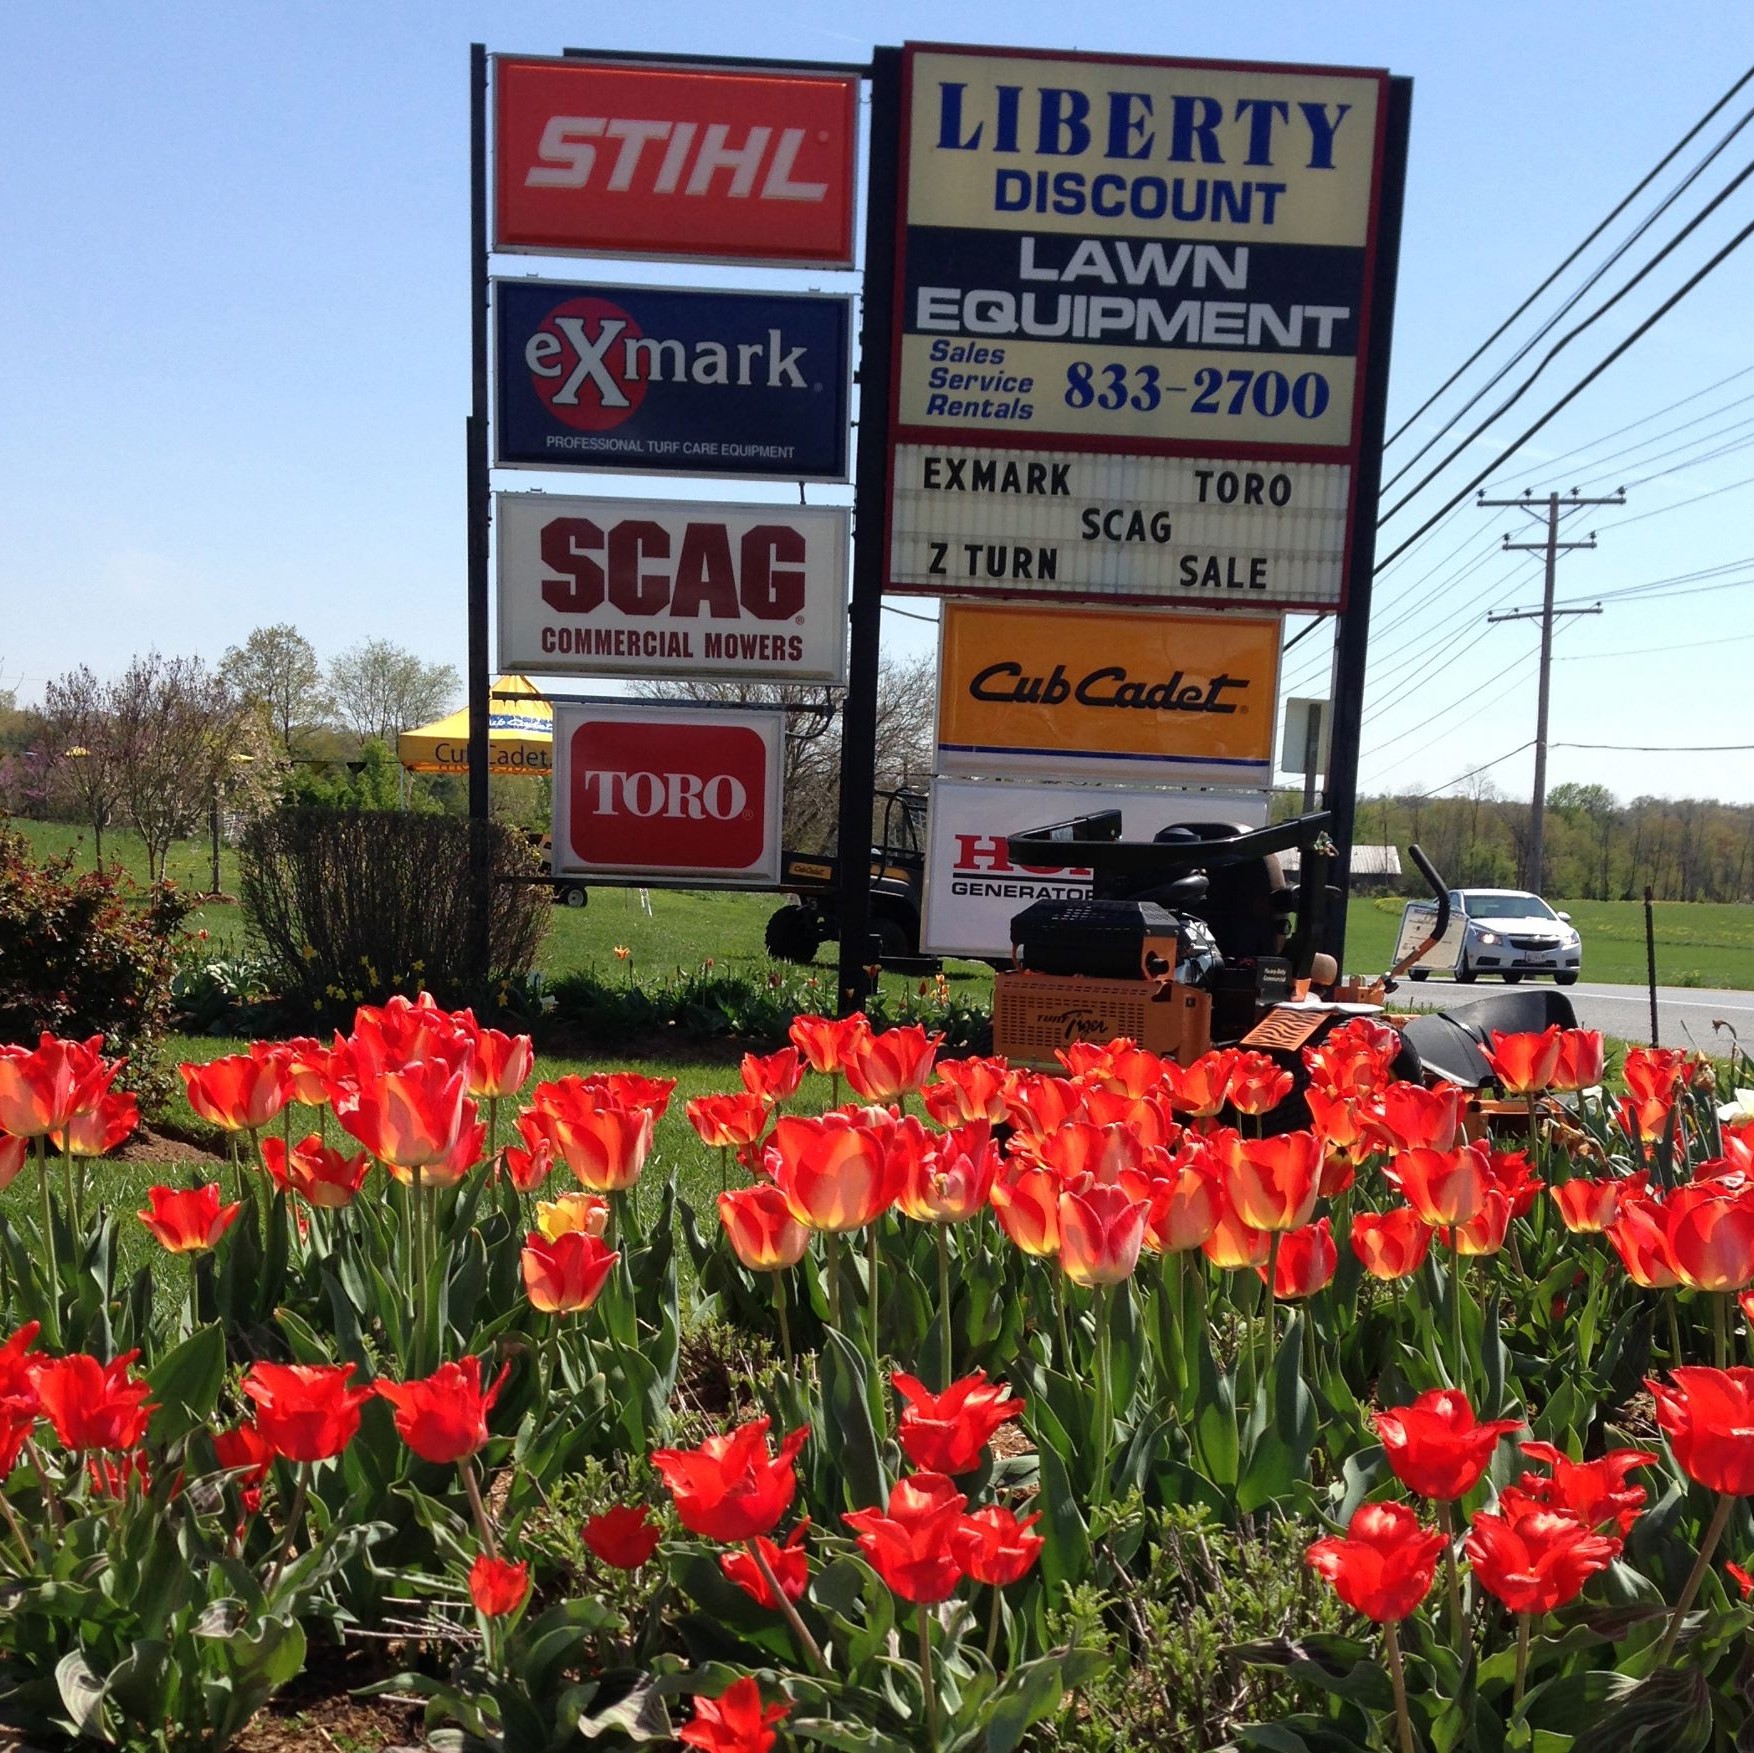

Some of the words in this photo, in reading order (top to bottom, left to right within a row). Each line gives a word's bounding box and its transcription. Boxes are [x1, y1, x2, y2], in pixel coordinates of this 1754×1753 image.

[936, 82, 1352, 169] LIBERTY
[525, 115, 828, 202] STIHL
[994, 169, 1287, 225] DISCOUNT
[1019, 236, 1249, 290] LAWN
[916, 286, 1350, 348] EQUIPMENT
[929, 339, 1005, 366] Sales
[928, 366, 1034, 394] Service
[1064, 361, 1330, 419] 833-2700
[926, 394, 1034, 420] Rentals
[546, 435, 644, 452] PROFESSIONAL
[647, 440, 681, 454] TURF
[683, 442, 718, 455] CARE
[721, 443, 795, 458] EQUIPMENT
[923, 456, 1072, 496] EXMARK
[1194, 469, 1292, 507] TORO
[1081, 507, 1172, 544] SCAG
[540, 516, 806, 620] SCAG
[929, 542, 947, 575] Z
[964, 544, 1057, 580] TURN
[1180, 555, 1267, 590] SALE
[541, 626, 694, 658] COMMERCIAL
[704, 632, 803, 661] MOWERS
[969, 662, 1070, 704] Cub
[1075, 667, 1250, 714] Cadet
[584, 770, 747, 820] TORO
